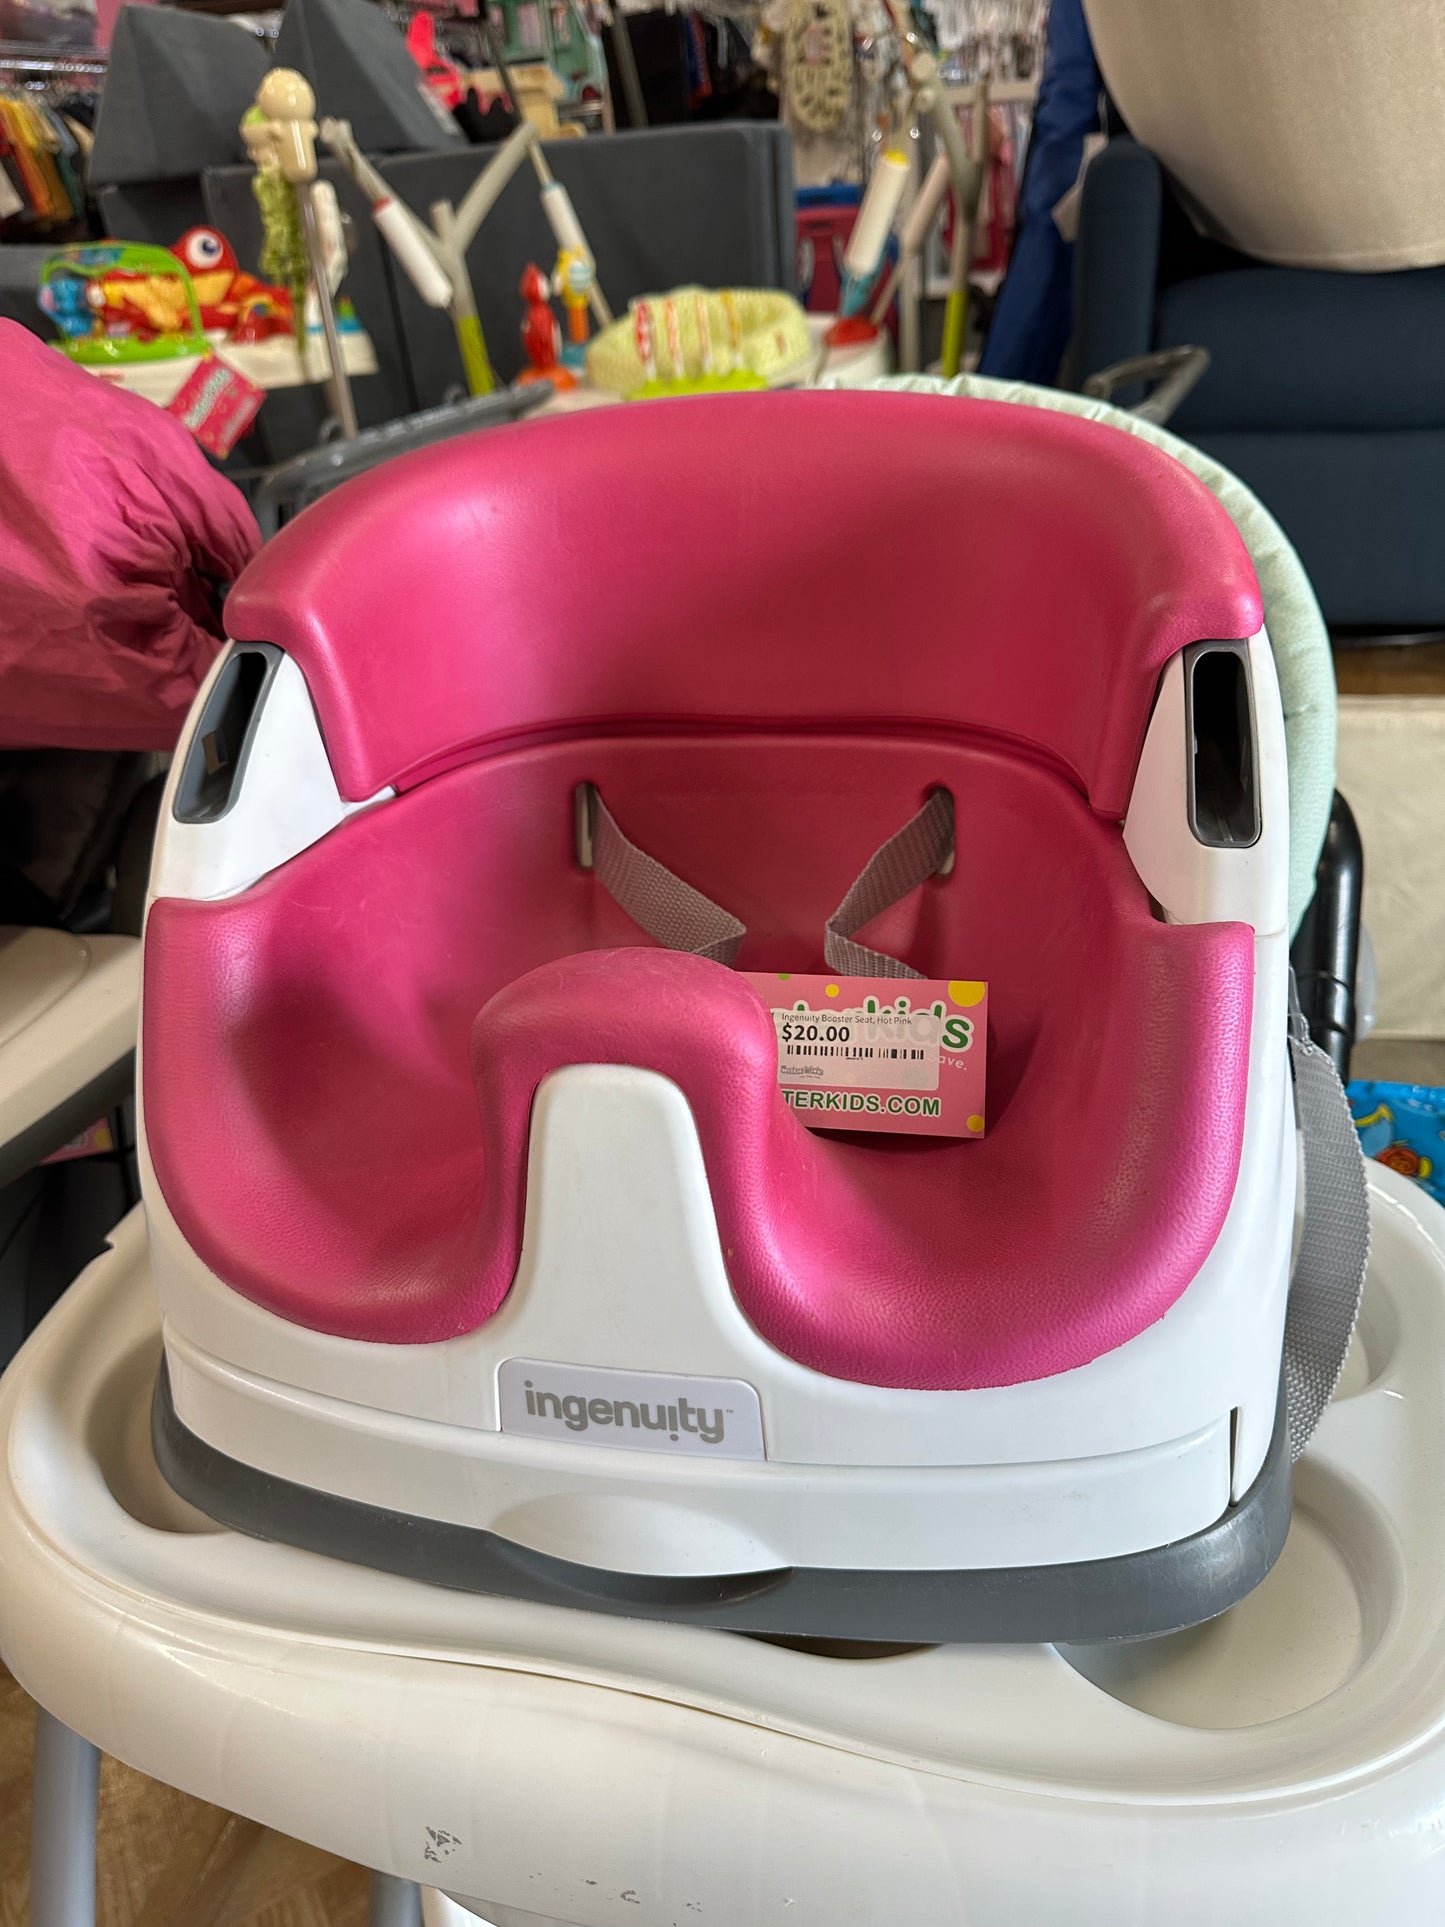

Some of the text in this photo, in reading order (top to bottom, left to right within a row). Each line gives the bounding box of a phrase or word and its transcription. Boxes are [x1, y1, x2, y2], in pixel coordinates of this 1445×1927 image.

[781, 1013, 913, 1026] Ingenuity Booster Seat, Hot Pink
[781, 1022, 851, 1043] $20.00
[523, 1379, 725, 1445] ingenuity
